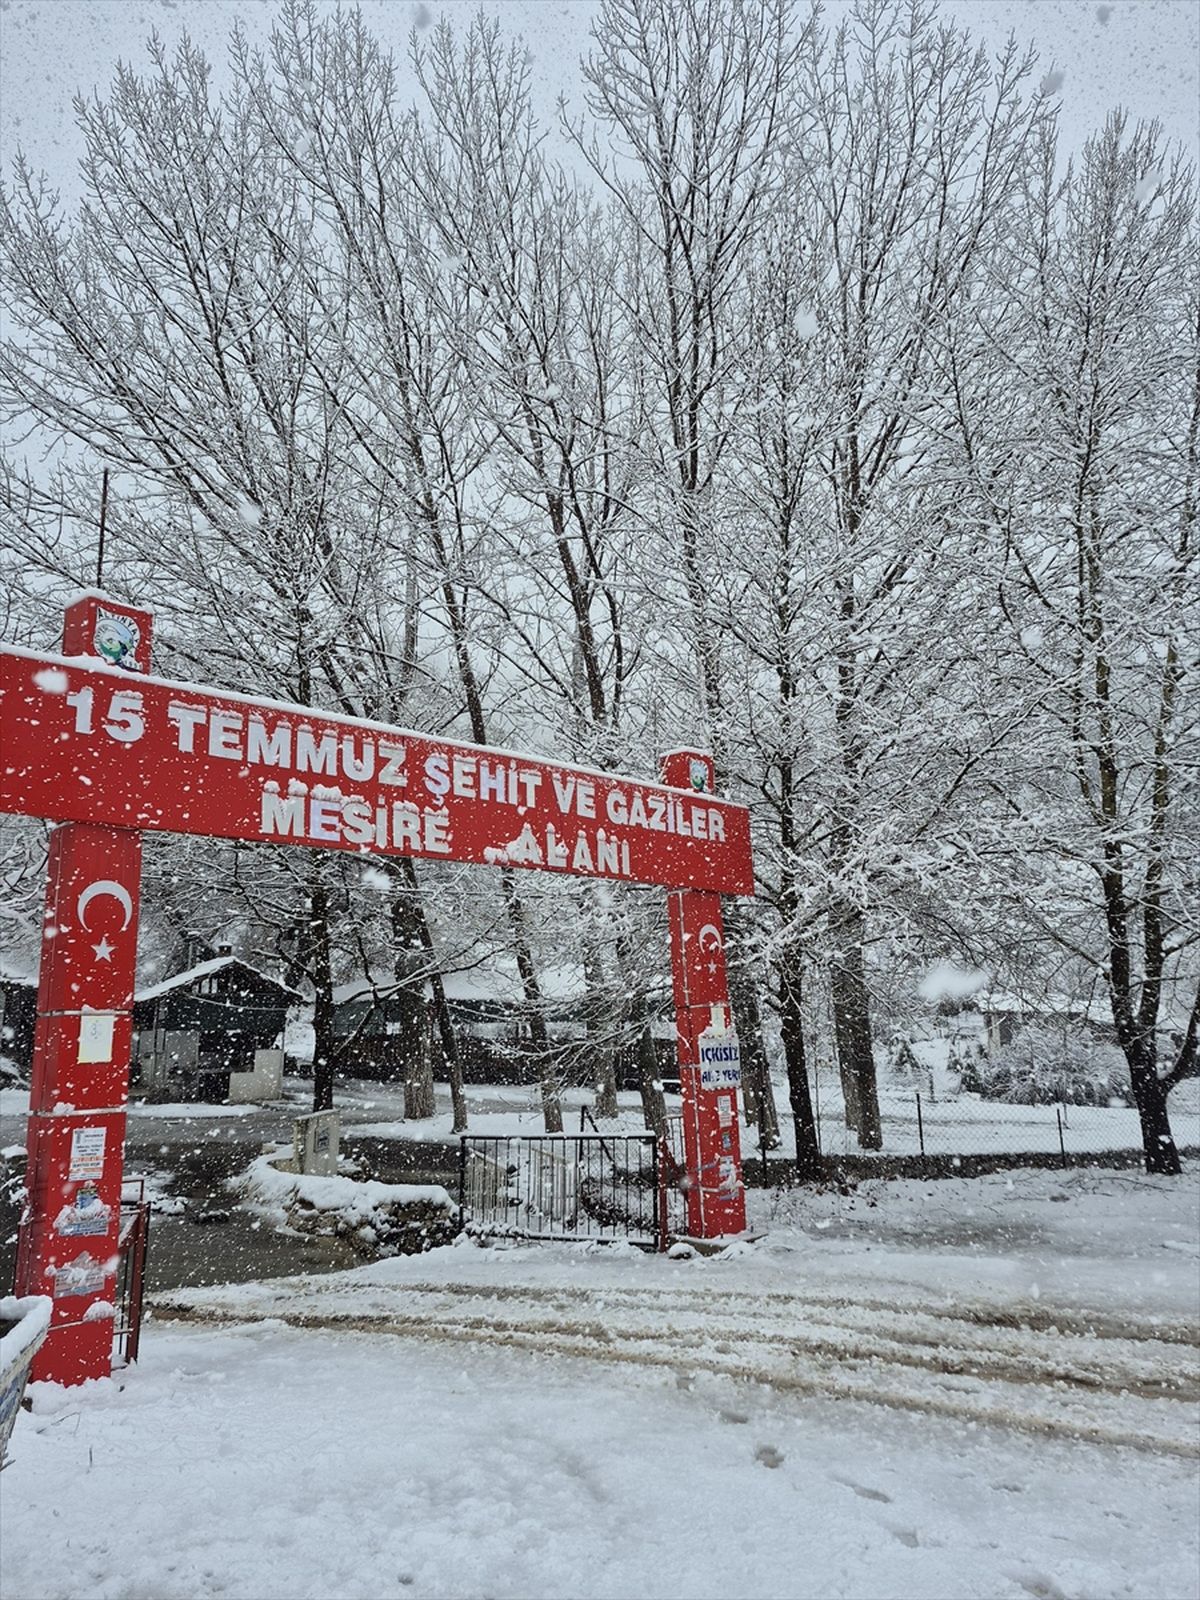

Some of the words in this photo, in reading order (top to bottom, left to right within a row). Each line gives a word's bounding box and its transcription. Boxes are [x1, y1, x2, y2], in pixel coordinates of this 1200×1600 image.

[67, 687, 145, 742] 15
[168, 704, 409, 787] TEMMUZ
[423, 753, 542, 808] ŞEHİT
[552, 773, 596, 819] VE
[606, 790, 725, 842] GAZİLER
[261, 783, 451, 853] MESİRE
[518, 824, 630, 875] ALANI
